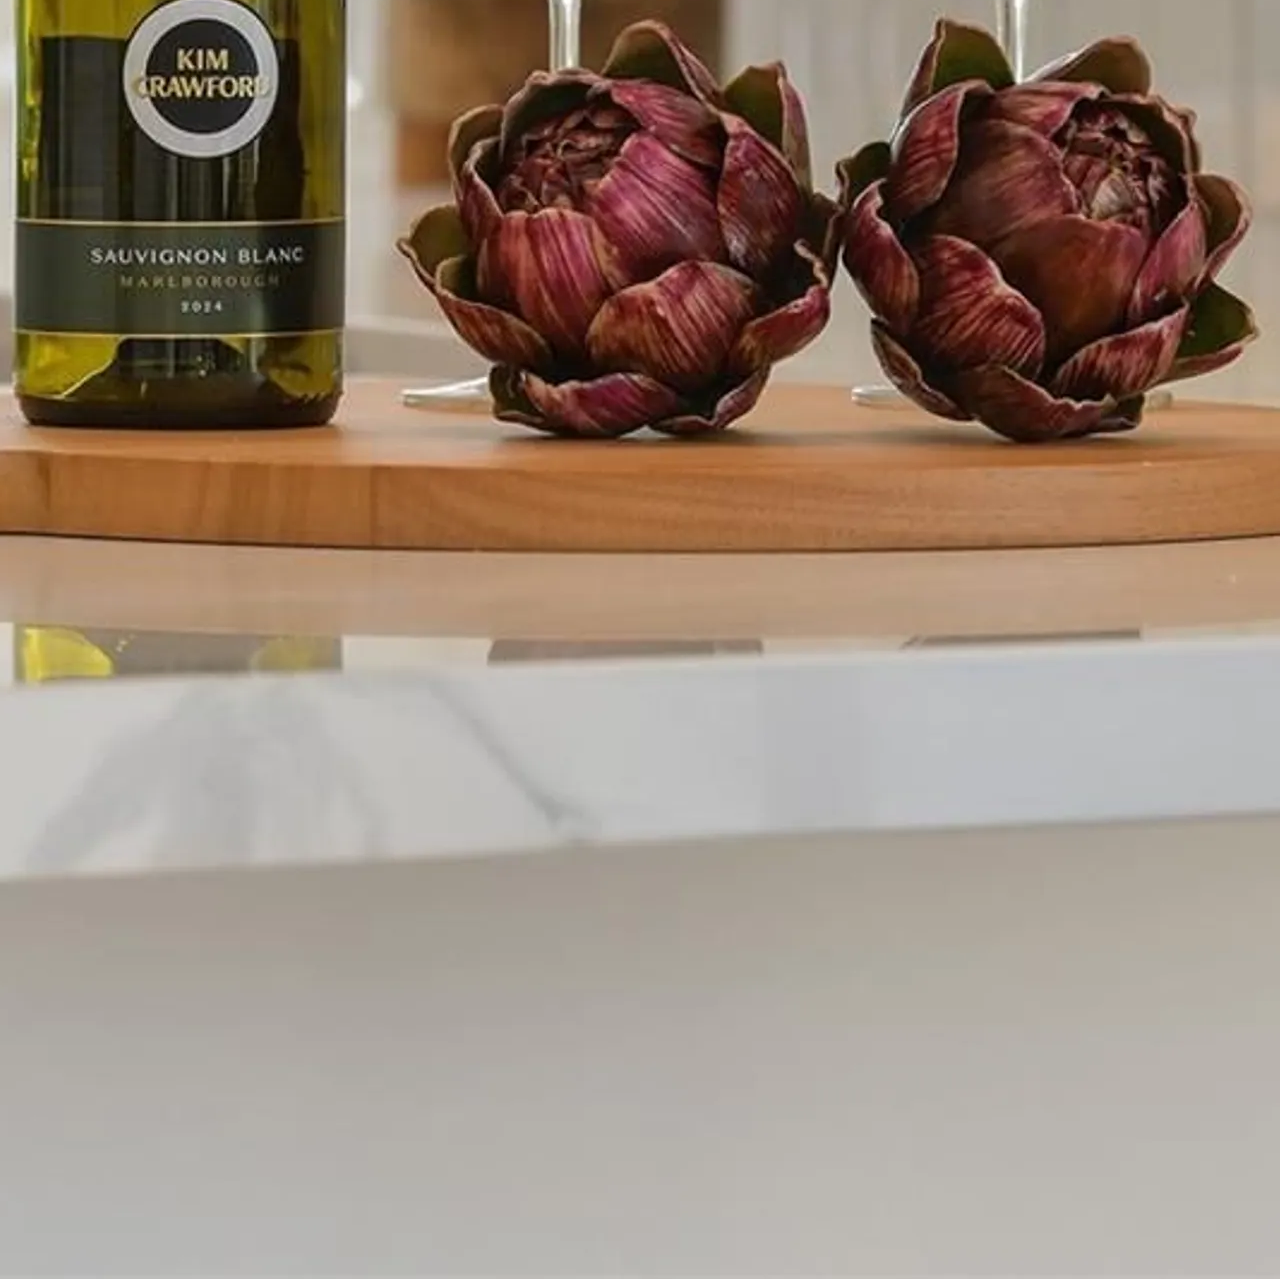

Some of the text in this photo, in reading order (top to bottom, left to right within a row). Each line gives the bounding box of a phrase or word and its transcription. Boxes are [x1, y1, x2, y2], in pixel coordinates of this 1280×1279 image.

[176, 47, 229, 71] KIM
[133, 75, 270, 99] CRAWFORD
[90, 246, 304, 264] SAUVIGNON BLANC
[120, 275, 279, 288] MARLBOROUGH
[180, 300, 222, 314] 2024
